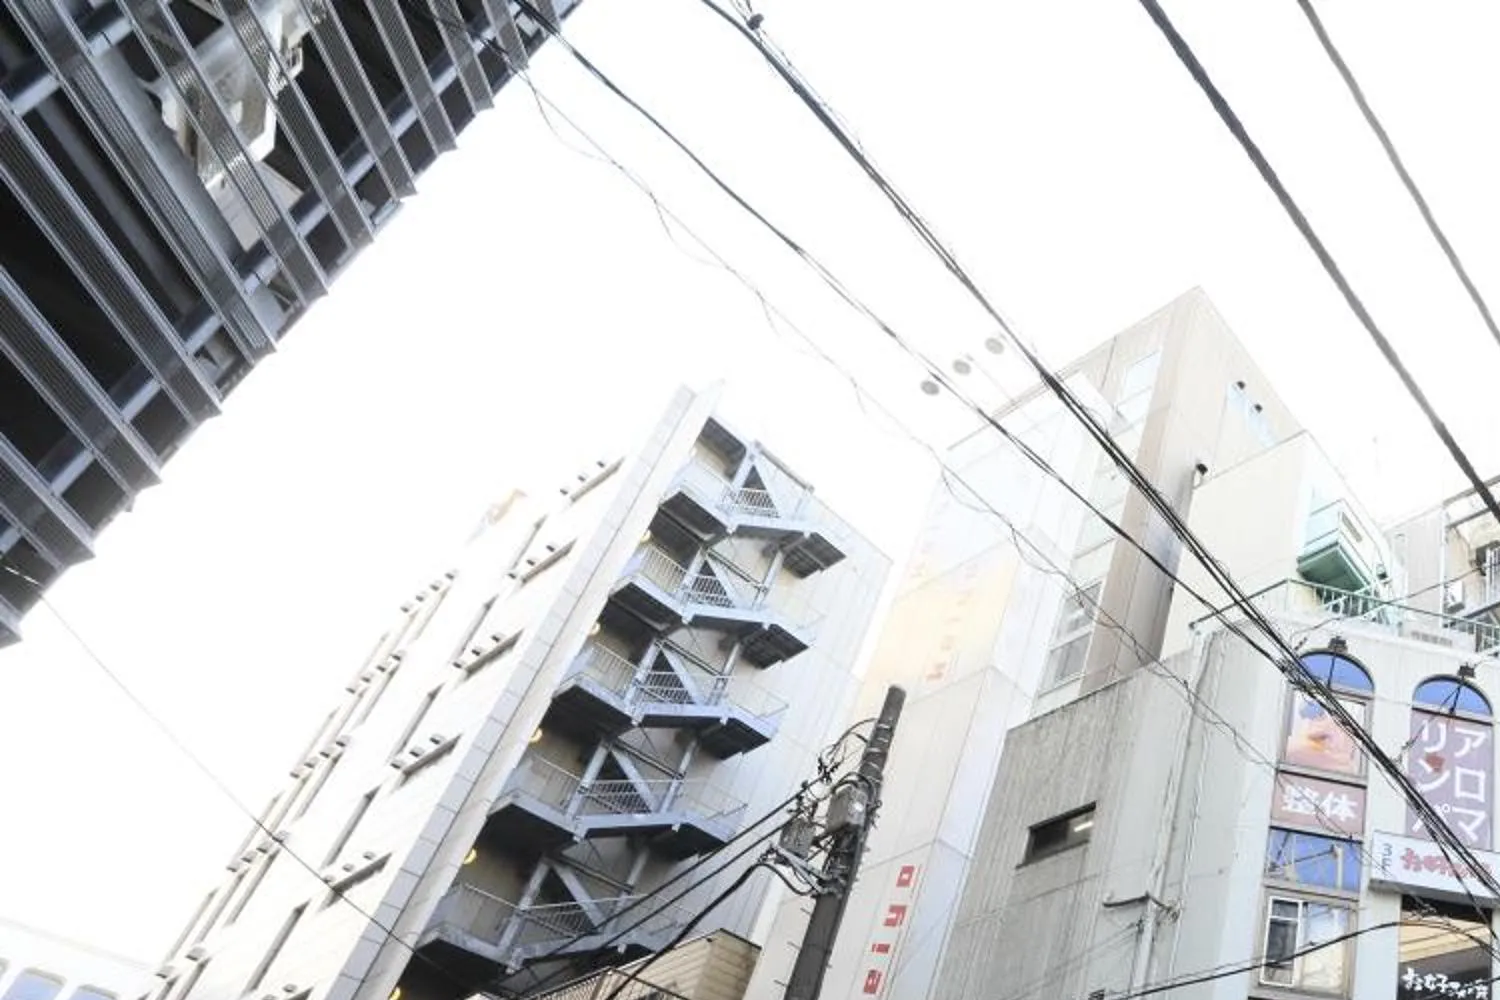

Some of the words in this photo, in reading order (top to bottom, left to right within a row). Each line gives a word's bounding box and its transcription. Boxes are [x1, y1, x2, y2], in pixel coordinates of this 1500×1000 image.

[1281, 784, 1359, 819] 整体
[1453, 727, 1491, 841] アロマ
